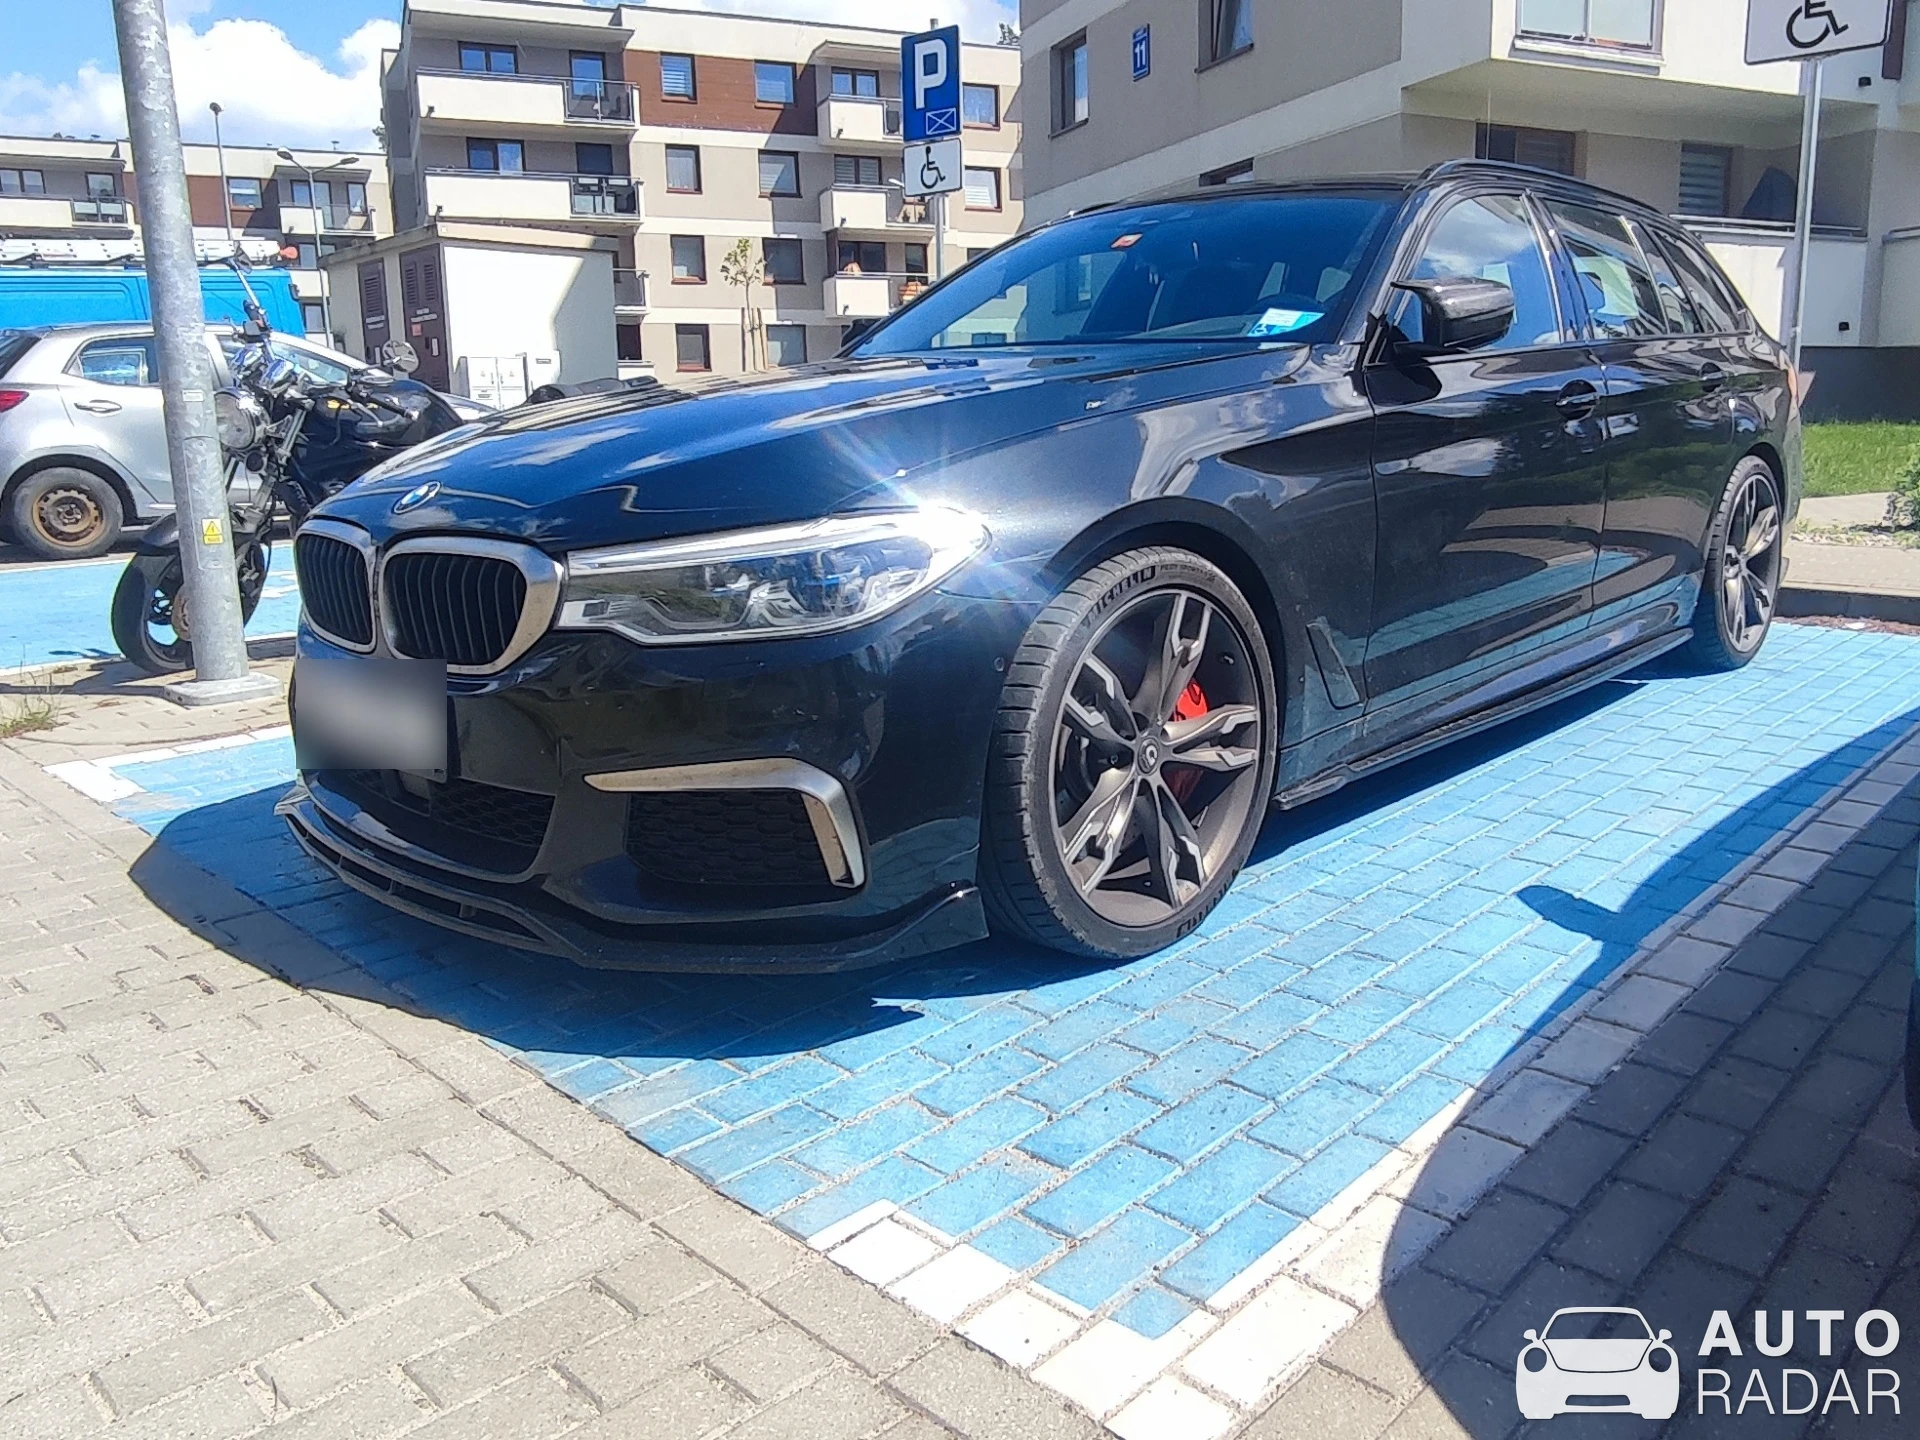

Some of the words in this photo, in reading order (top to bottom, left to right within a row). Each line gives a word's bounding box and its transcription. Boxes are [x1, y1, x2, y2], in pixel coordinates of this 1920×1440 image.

[914, 39, 947, 110] P
[1135, 40, 1146, 68] 11
[1080, 565, 1156, 629] MICHELIN
